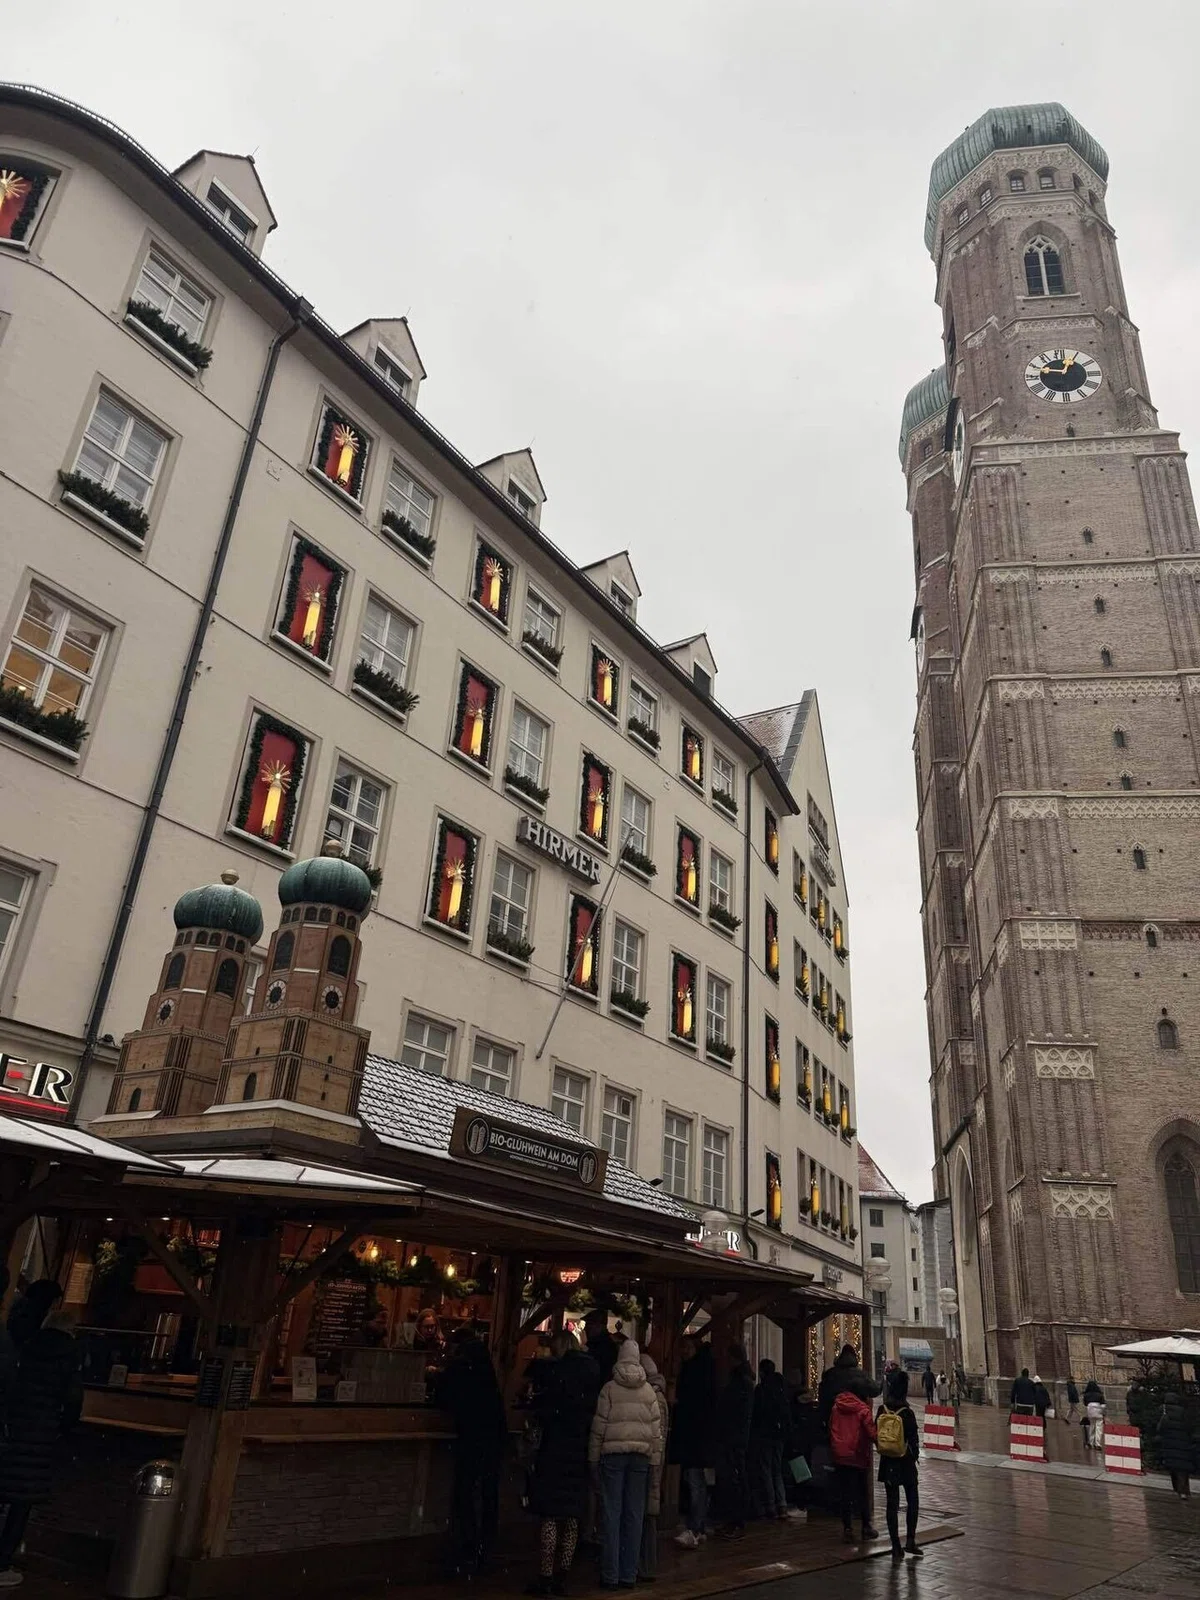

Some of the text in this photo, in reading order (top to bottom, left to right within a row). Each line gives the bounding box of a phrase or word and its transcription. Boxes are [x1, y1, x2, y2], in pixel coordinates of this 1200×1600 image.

[526, 816, 600, 881] HIRMER
[490, 1132, 547, 1157] BIO-GLÜHWEIN
[548, 1151, 560, 1163] AM
[561, 1153, 579, 1168] DOM
